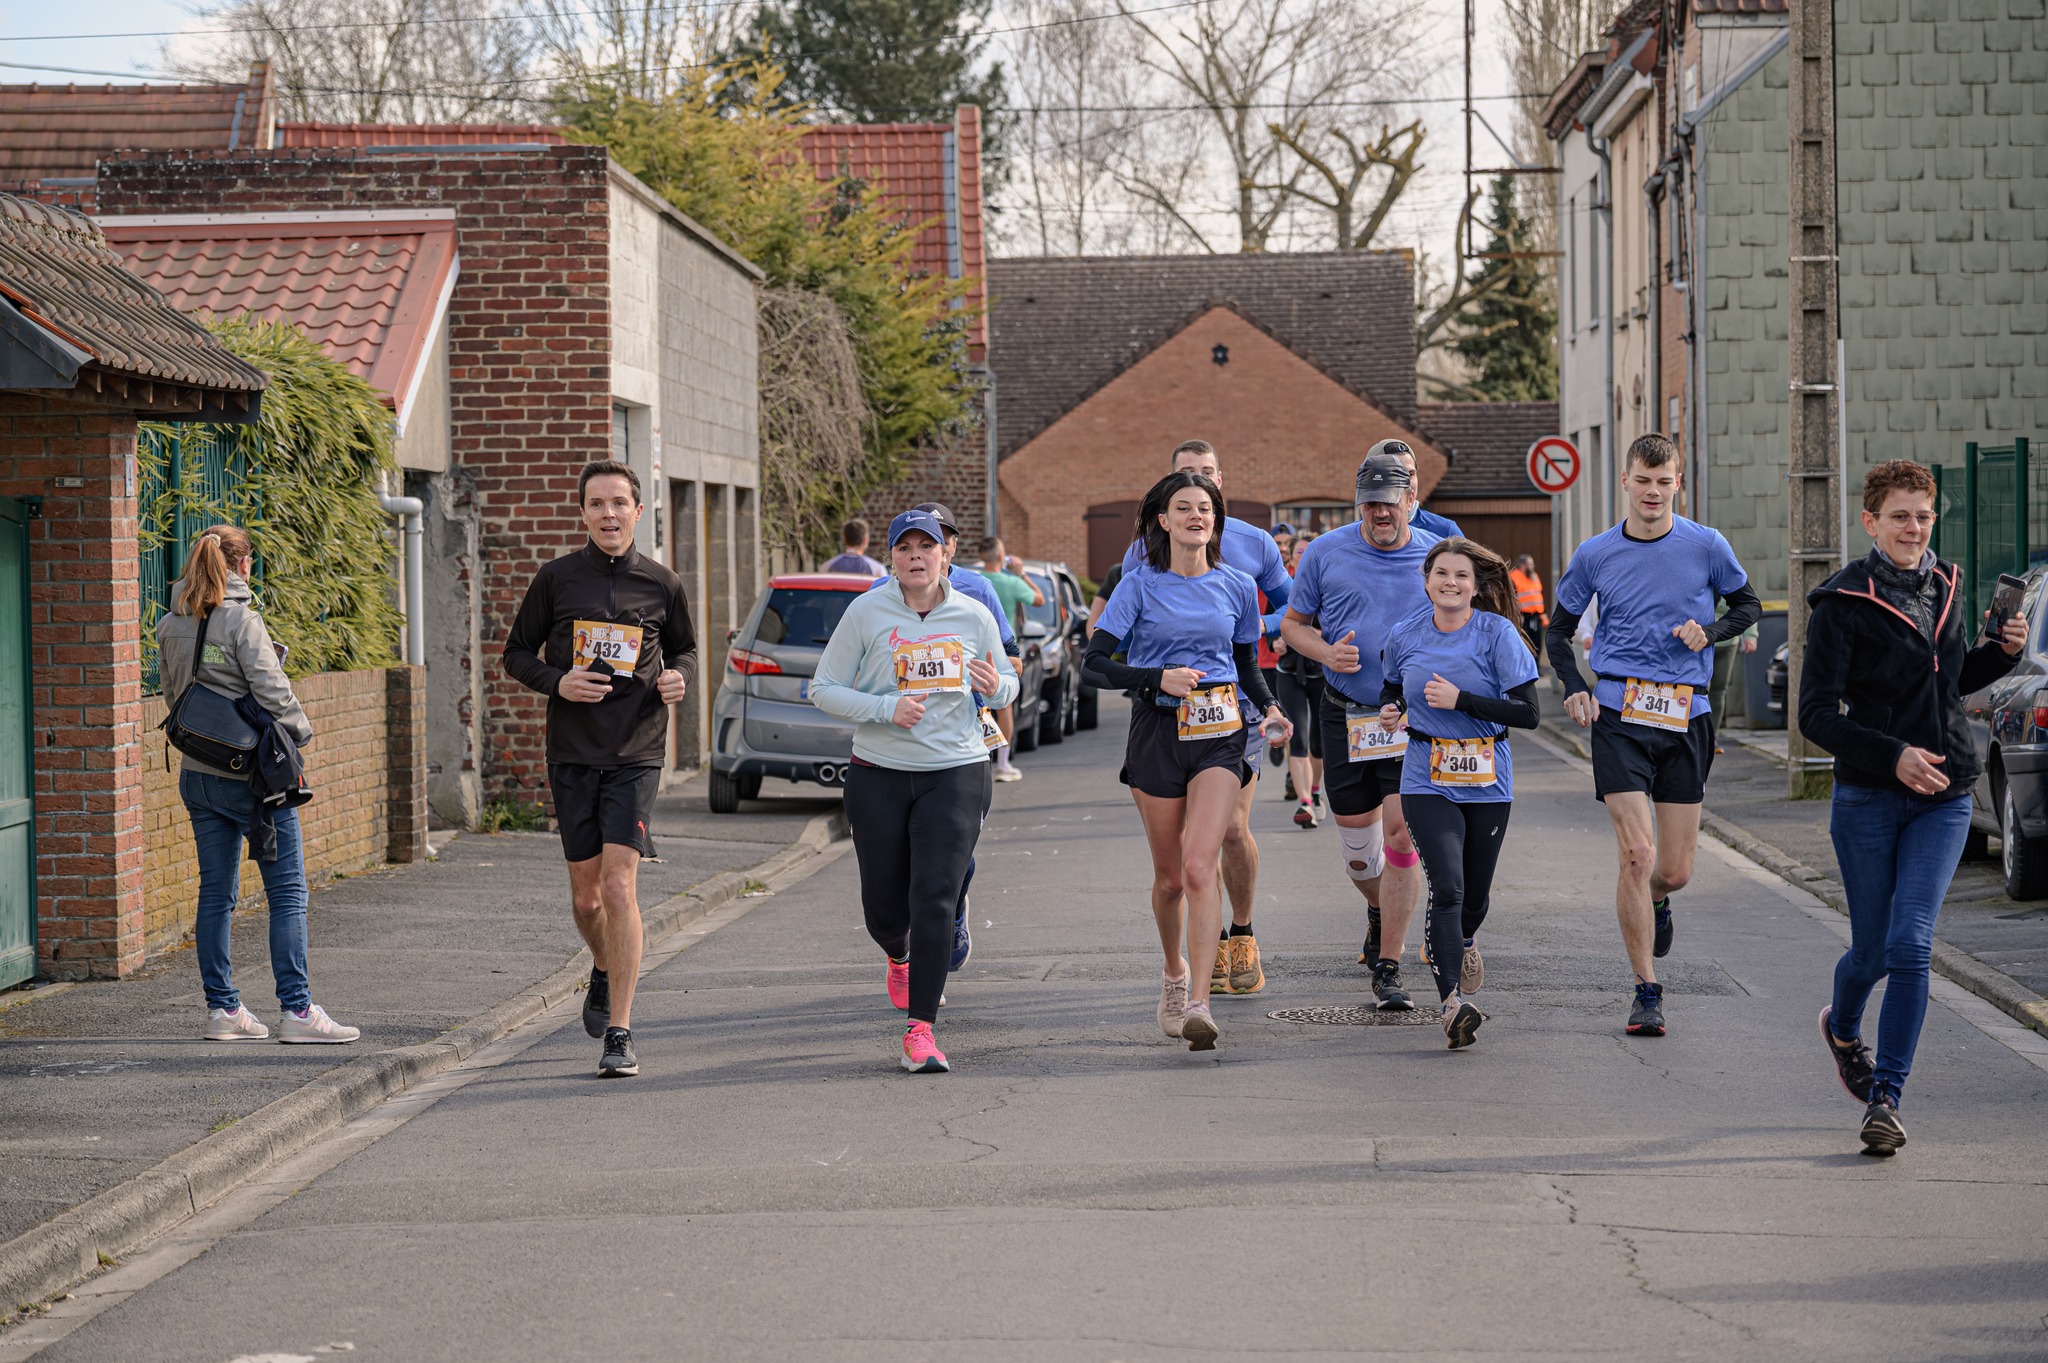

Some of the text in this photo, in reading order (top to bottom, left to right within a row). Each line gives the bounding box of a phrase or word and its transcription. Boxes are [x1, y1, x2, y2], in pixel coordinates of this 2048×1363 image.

[593, 641, 621, 659] 432
[918, 660, 944, 677] 431
[1645, 695, 1670, 714] 341
[1198, 706, 1225, 723] 343
[1368, 732, 1394, 747] 342
[1449, 756, 1478, 772] 340
